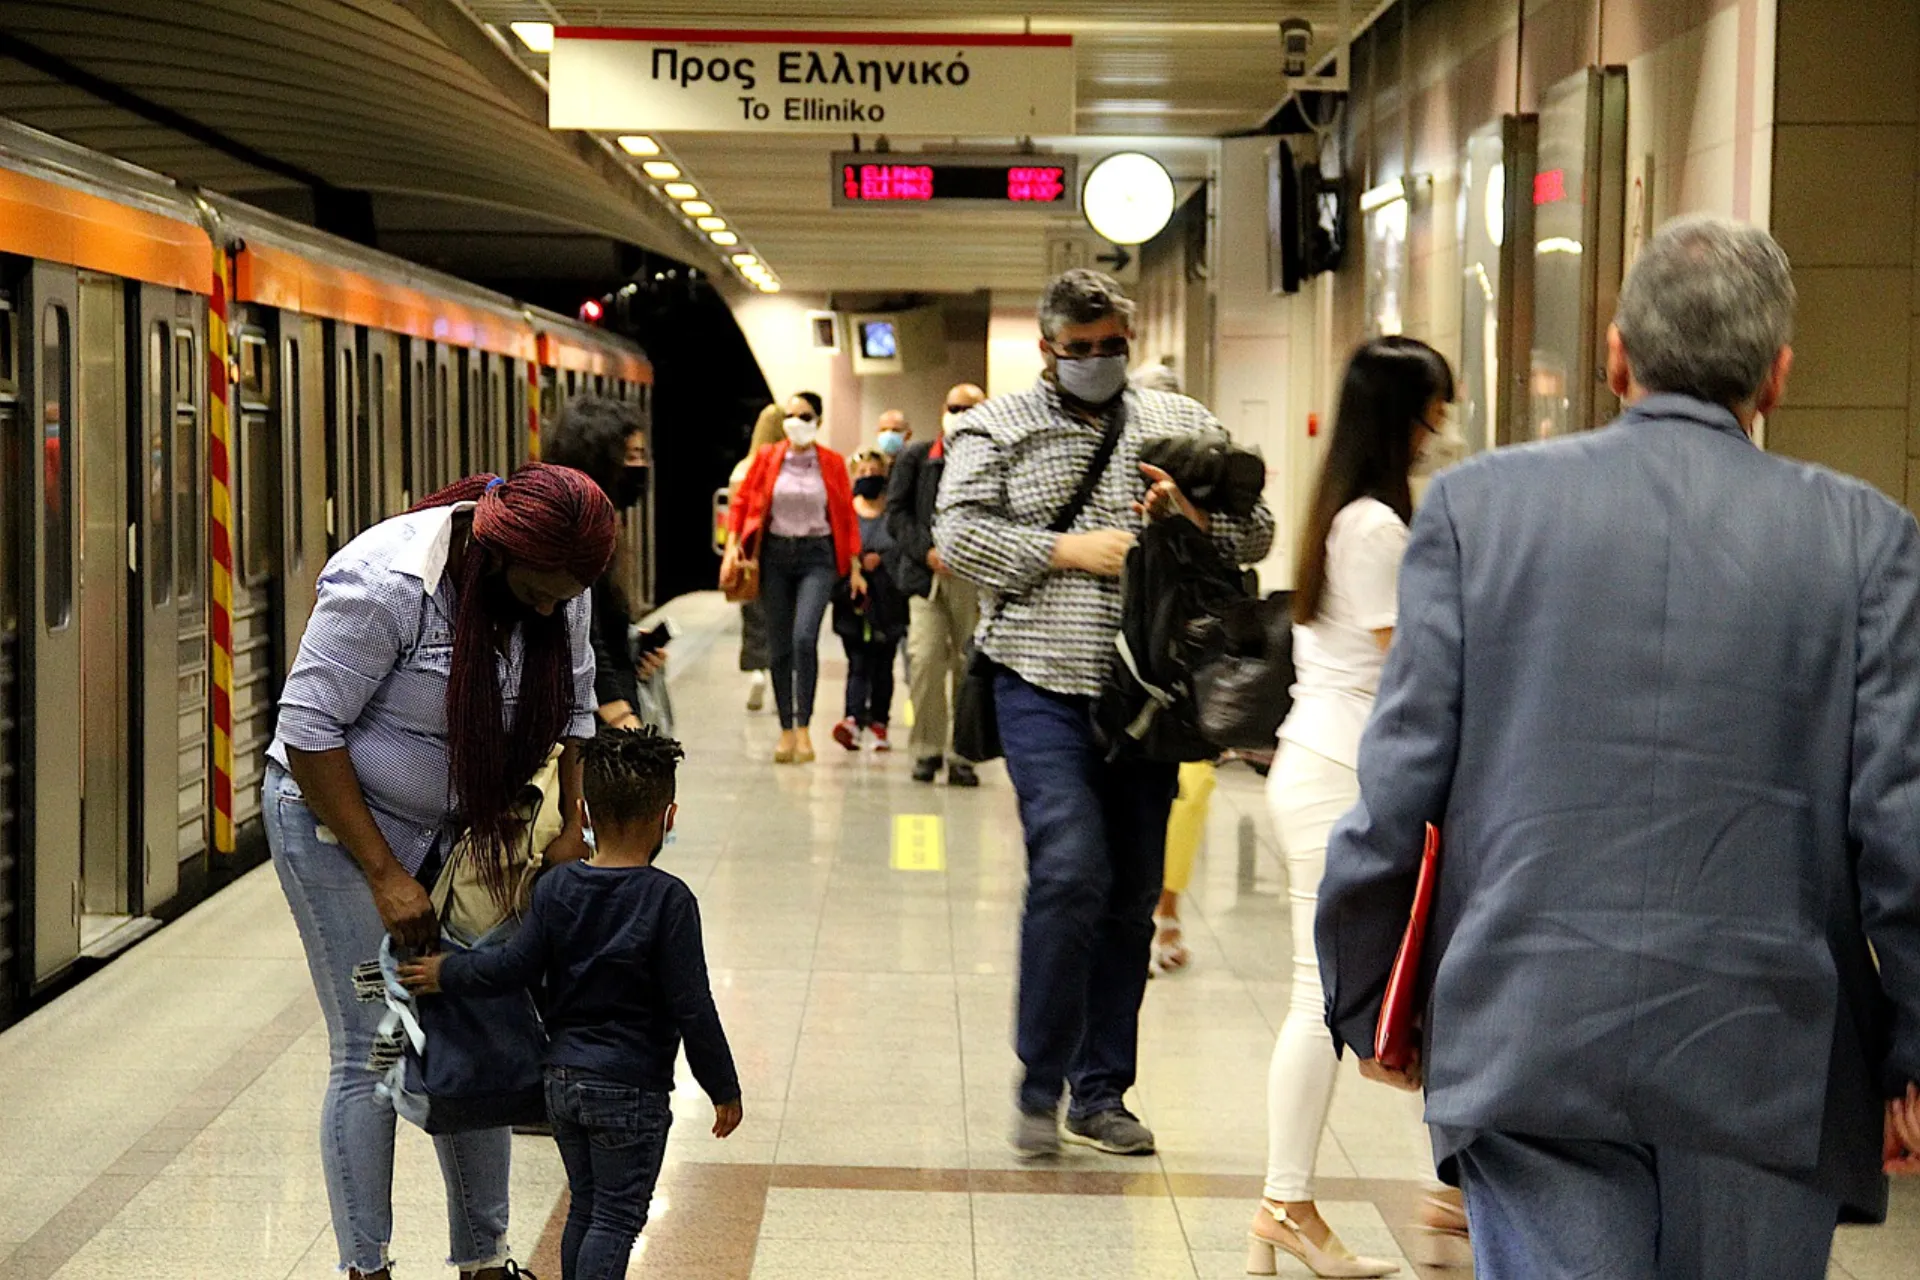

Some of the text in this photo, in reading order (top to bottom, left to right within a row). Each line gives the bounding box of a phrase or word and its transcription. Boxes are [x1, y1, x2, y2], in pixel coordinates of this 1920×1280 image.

[652, 48, 970, 92] Προς Ελληνικό
[738, 96, 885, 122] To Elliniko
